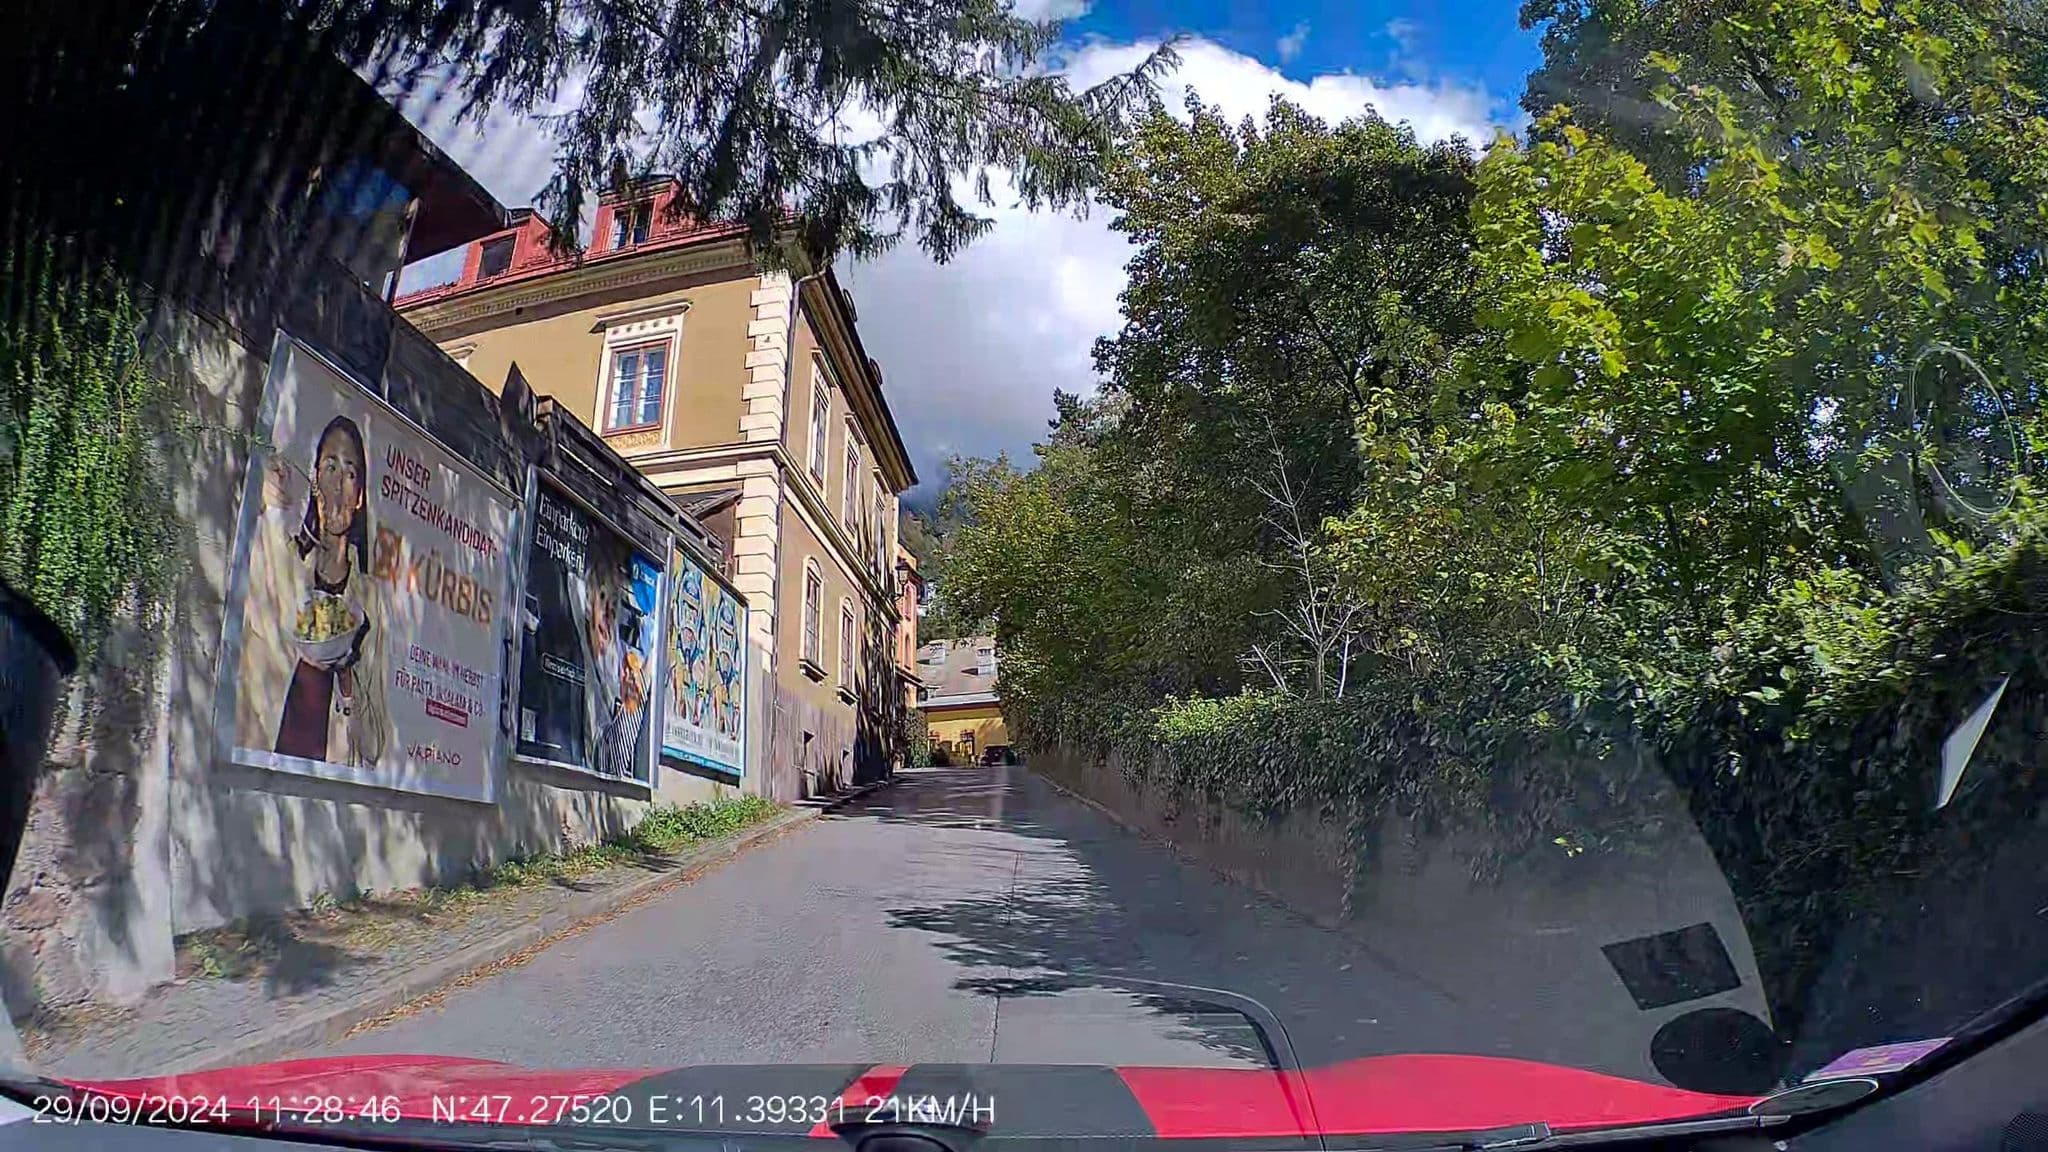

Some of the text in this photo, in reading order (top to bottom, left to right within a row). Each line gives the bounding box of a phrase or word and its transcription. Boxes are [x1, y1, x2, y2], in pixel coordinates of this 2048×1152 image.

[386, 443, 431, 491] UNSER
[536, 523, 586, 573] Einparken!
[407, 547, 492, 625] KÜRBIS
[407, 742, 461, 765] VAPIANO
